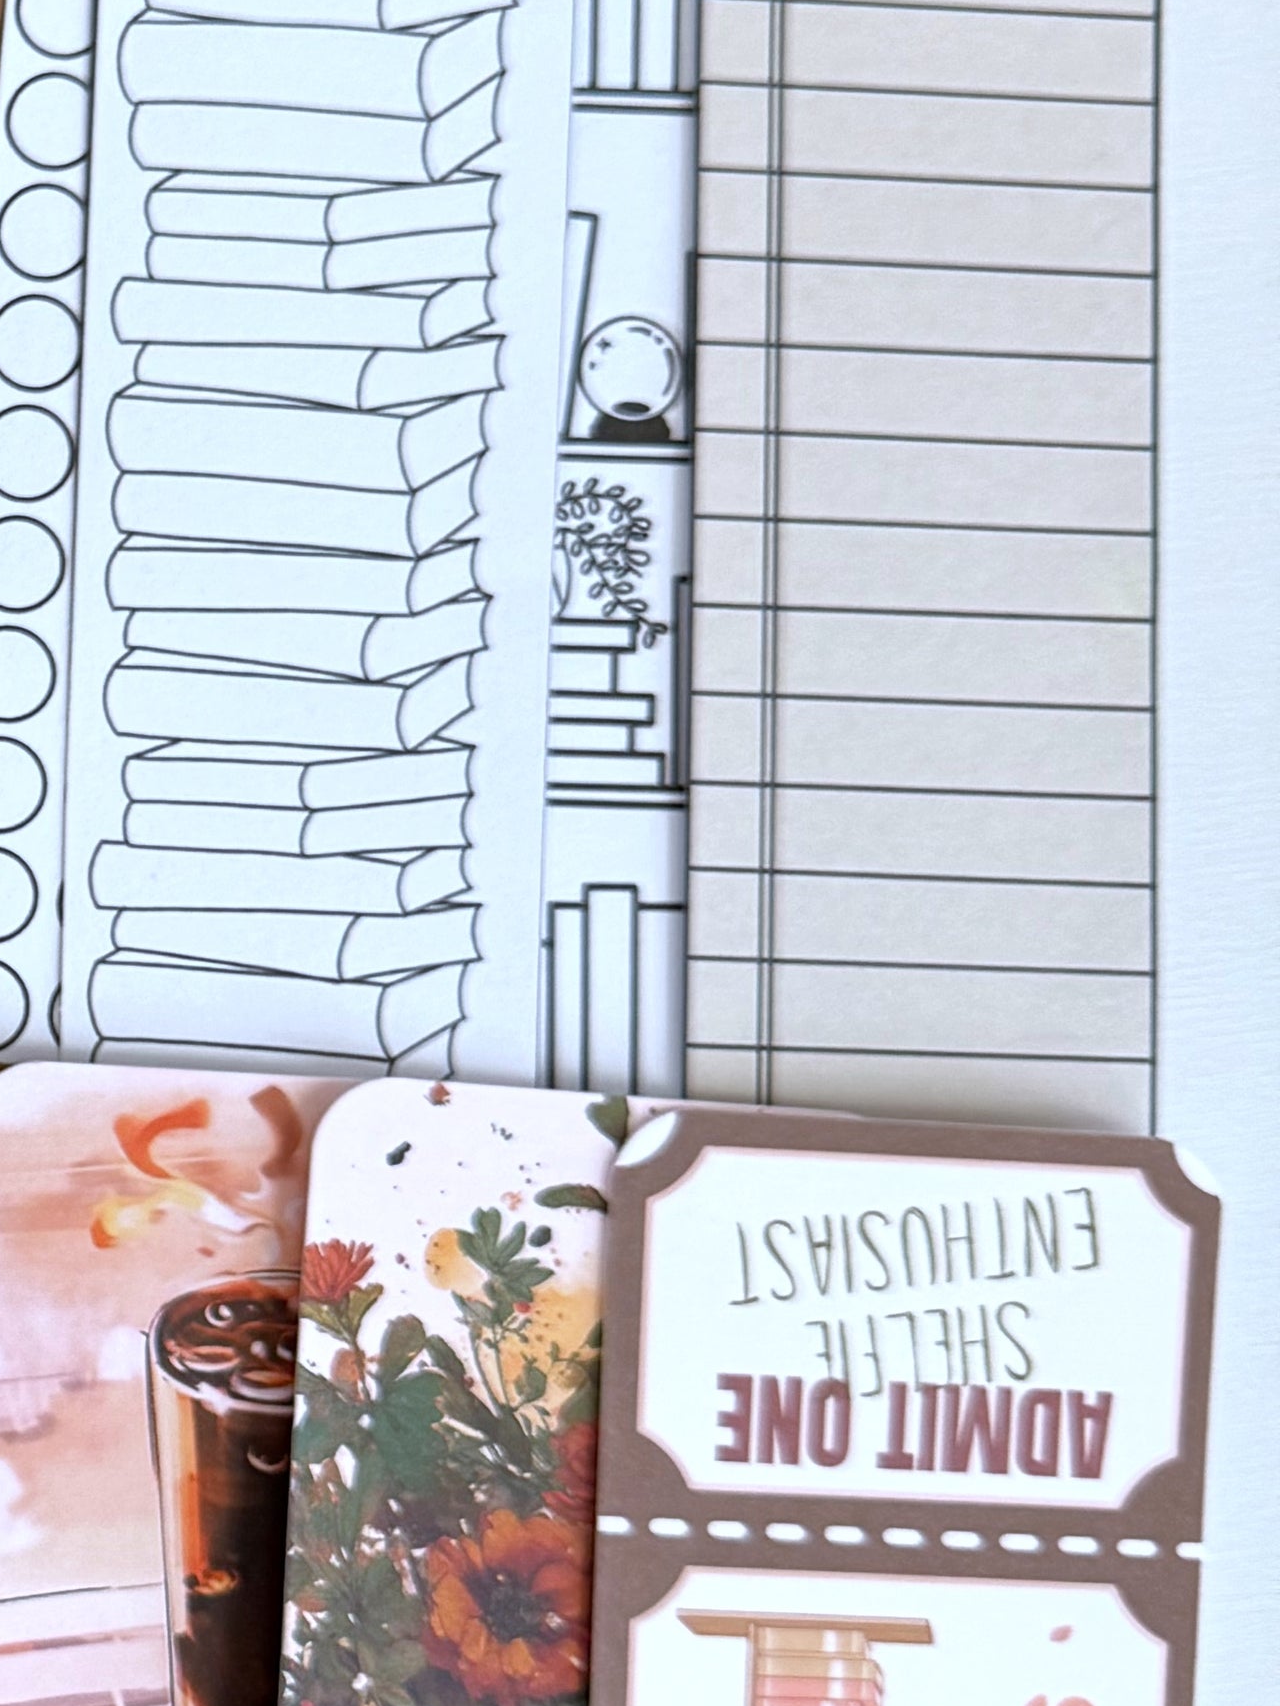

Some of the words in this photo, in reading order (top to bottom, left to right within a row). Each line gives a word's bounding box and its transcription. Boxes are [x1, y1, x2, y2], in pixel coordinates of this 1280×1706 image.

[729, 1187, 1101, 1306] ENTHUSIAST
[805, 1301, 1034, 1397] SHELFIE
[714, 1373, 851, 1468] ONE
[876, 1381, 1115, 1480] ADMIT
